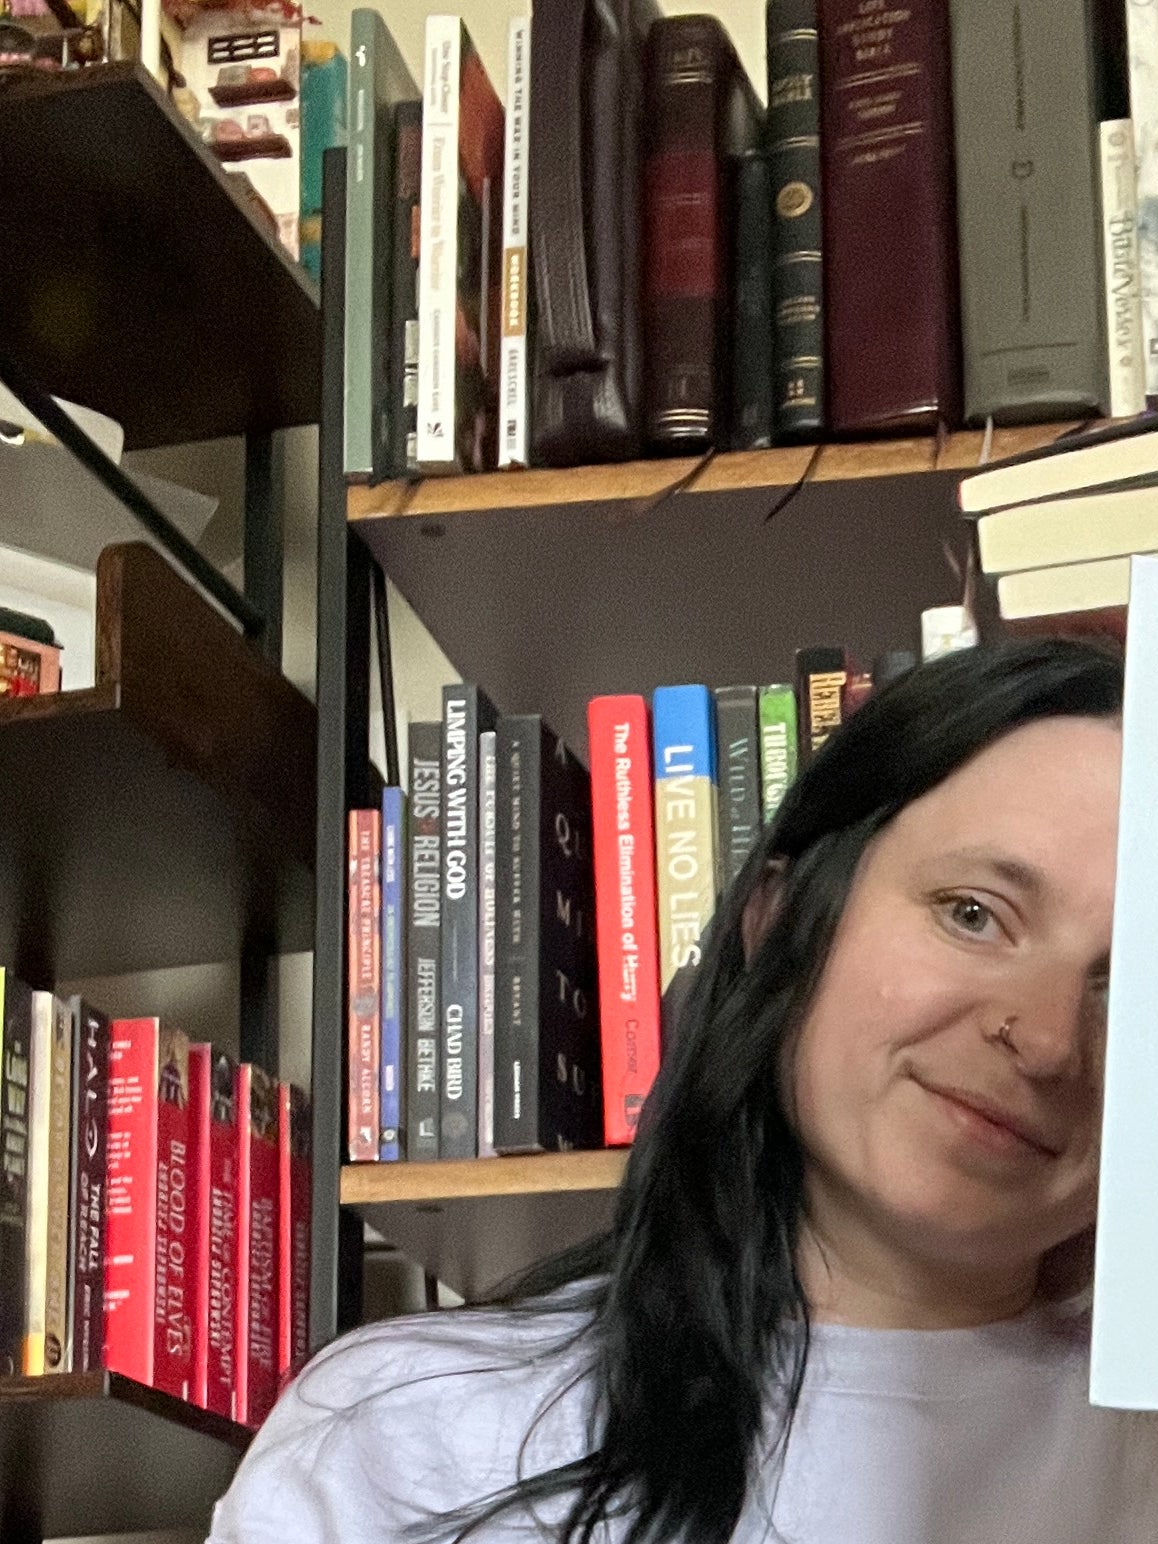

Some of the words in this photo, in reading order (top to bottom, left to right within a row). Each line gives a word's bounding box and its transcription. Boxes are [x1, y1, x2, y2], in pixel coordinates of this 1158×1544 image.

[514, 29, 524, 84] WINNING
[514, 90, 523, 111] THE
[512, 148, 522, 161] IN
[513, 116, 522, 143] WAR
[512, 166, 521, 199] YOUR
[511, 204, 520, 235] MIND
[445, 699, 468, 785] LIMPING
[612, 723, 631, 754] The
[413, 758, 440, 818] JESUS
[615, 757, 633, 830] Ruthless
[664, 745, 696, 822] LIVE
[360, 830, 373, 851] THE
[446, 788, 468, 848] WITH
[413, 835, 440, 927] RELIGION
[446, 850, 468, 899] GOD
[618, 834, 636, 930] Elimination
[667, 830, 699, 881] NO
[360, 857, 373, 913] TREASURE
[360, 918, 372, 979] PRINCIPLE
[621, 932, 638, 951] of
[669, 891, 702, 968] LIES
[417, 957, 436, 1031] JEFFERSON
[620, 954, 640, 1001] Hurry
[360, 1024, 373, 1062] RANDY
[446, 1003, 464, 1055] CHAD
[624, 1018, 640, 1074] Comer
[85, 1018, 100, 1157] HALO
[360, 1067, 373, 1114] ALCORN
[416, 1038, 436, 1092] BETHKE
[446, 1058, 463, 1100] BIRD
[80, 1170, 89, 1200] OF
[90, 1183, 101, 1222] THE
[169, 1139, 186, 1234] BLOOD
[79, 1203, 89, 1274] REACH
[89, 1225, 100, 1270] FALL
[168, 1241, 185, 1279] OF
[166, 1286, 184, 1357] ELVES
[219, 1267, 235, 1387] CONTEMPT
